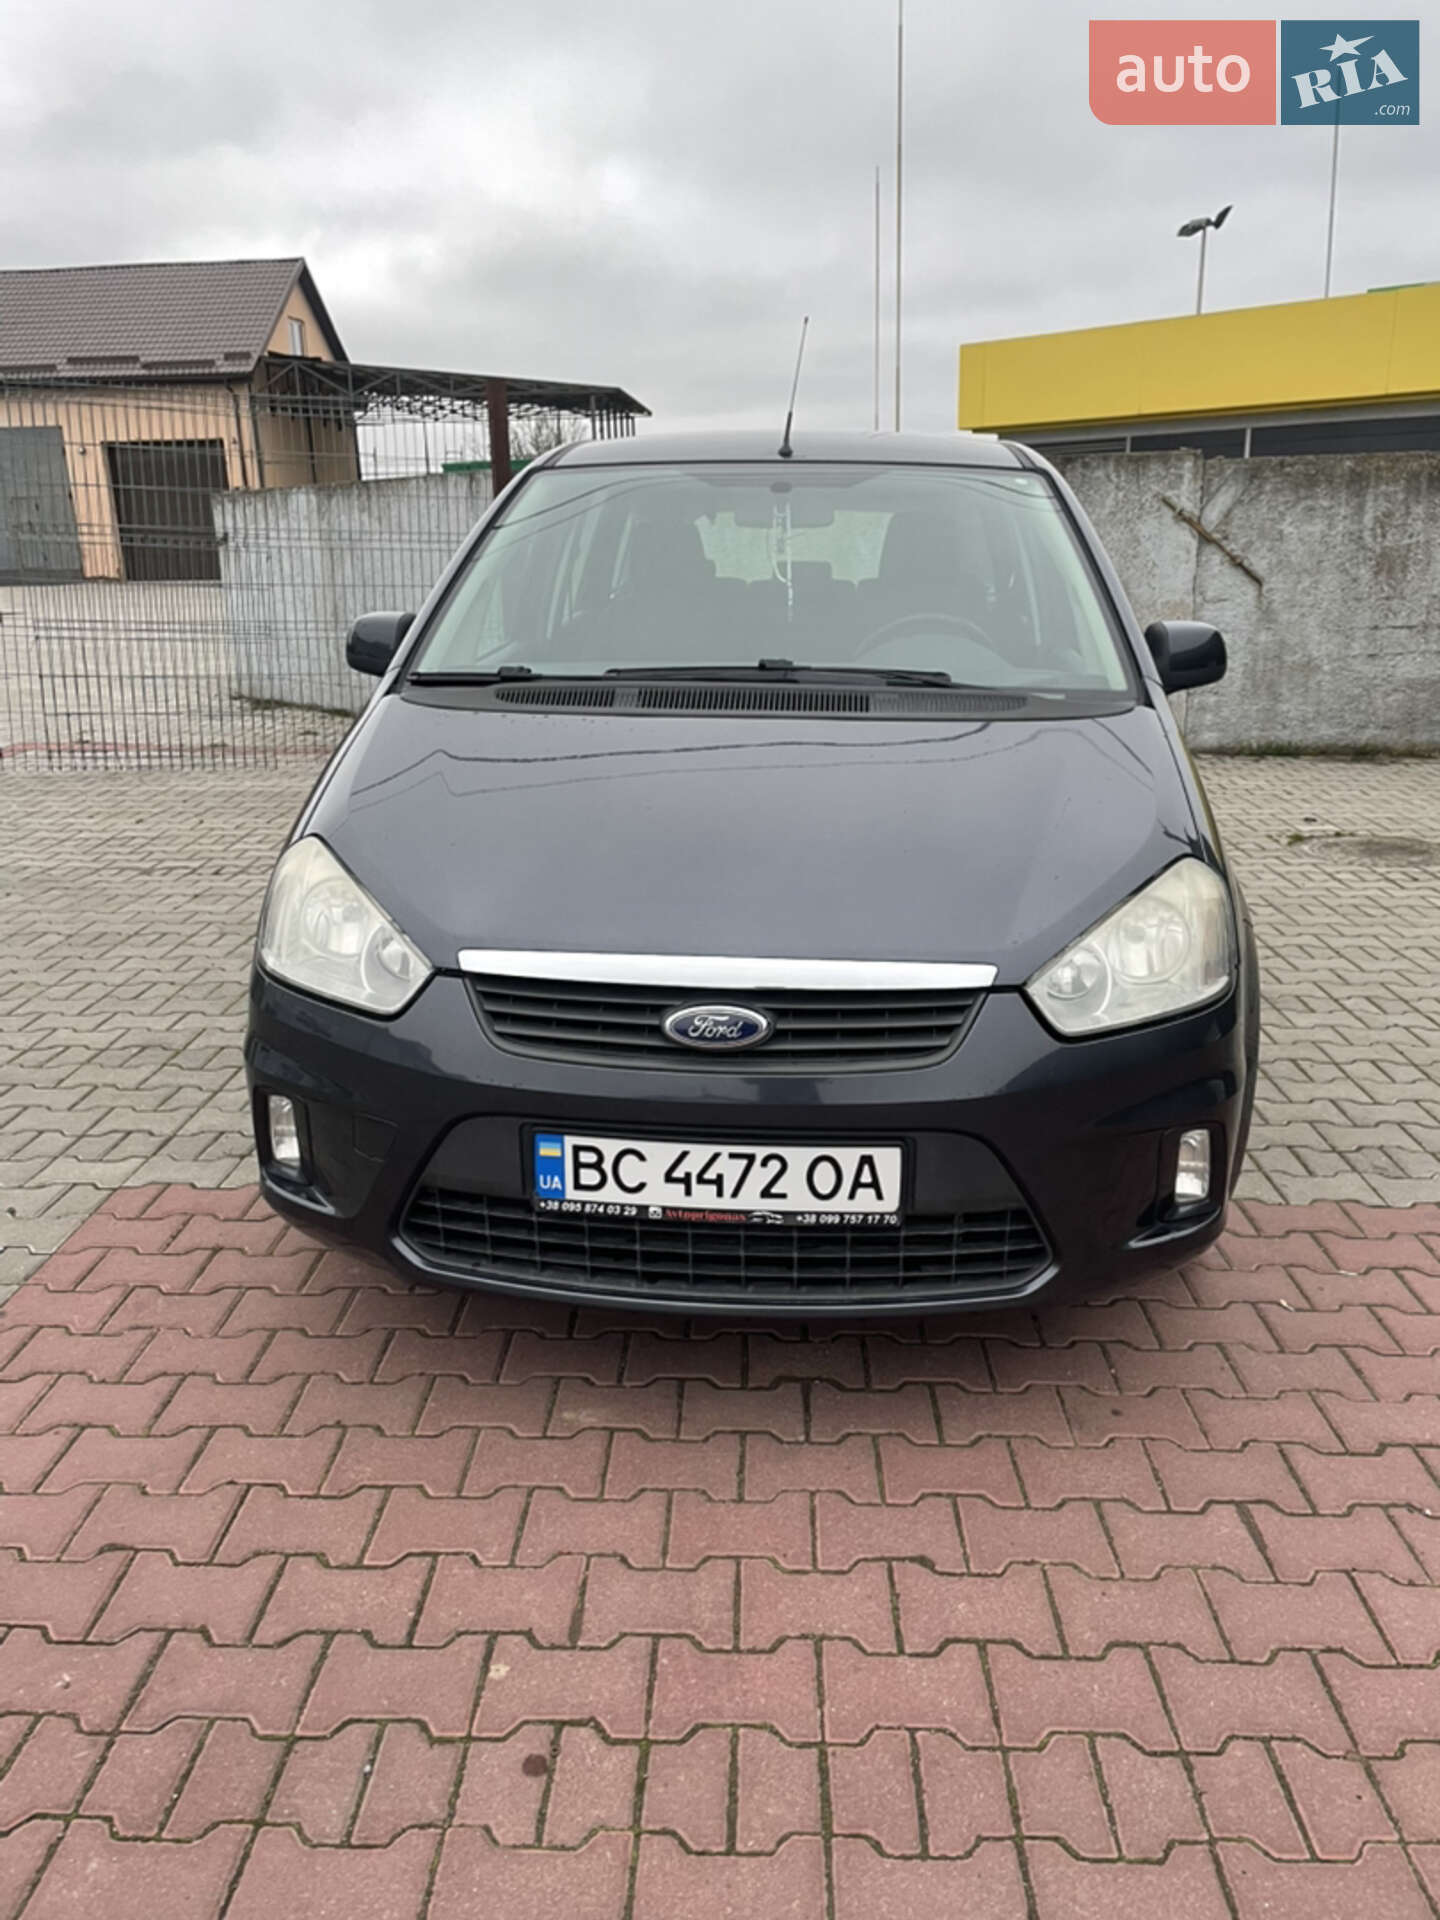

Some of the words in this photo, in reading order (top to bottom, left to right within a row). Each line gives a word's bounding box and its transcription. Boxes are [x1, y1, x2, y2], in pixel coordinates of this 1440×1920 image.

[688, 1015, 743, 1038] Ford
[572, 1144, 648, 1195] BC
[664, 1150, 788, 1200] 4472
[806, 1154, 884, 1201] OA
[539, 1175, 562, 1190] UA
[867, 1215, 880, 1225] 17
[883, 1215, 897, 1225] 70
